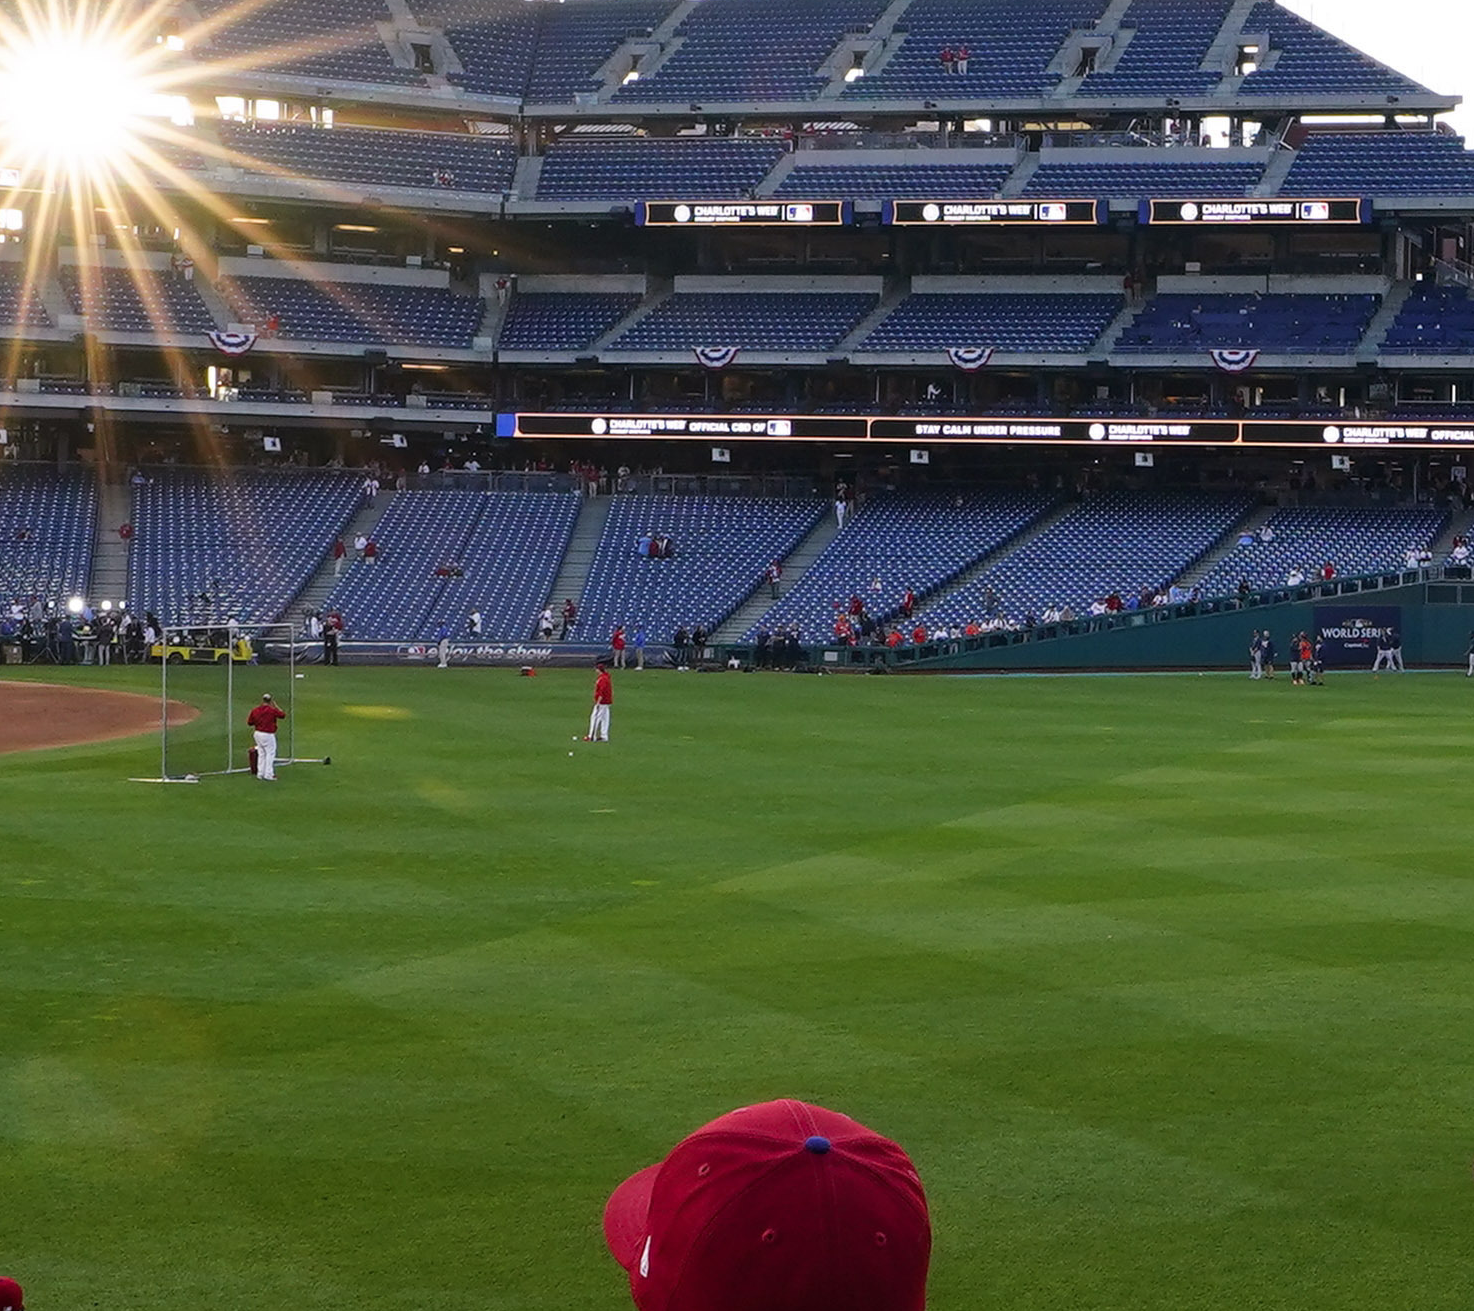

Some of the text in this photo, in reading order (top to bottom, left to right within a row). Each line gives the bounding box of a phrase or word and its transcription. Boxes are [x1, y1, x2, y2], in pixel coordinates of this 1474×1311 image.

[694, 205, 778, 216] CHARLOTTE'S WEB
[943, 204, 1031, 216] CHARLOTTE'S WEB
[1202, 203, 1292, 215] CHARLOTTE'S WEB
[689, 421, 730, 433] OFFICIAL
[753, 422, 766, 433] OF
[915, 424, 1061, 436] STAY CALM UNDER PRESSURE
[1322, 627, 1359, 639] WORLD
[426, 643, 554, 661] ejoy the show
